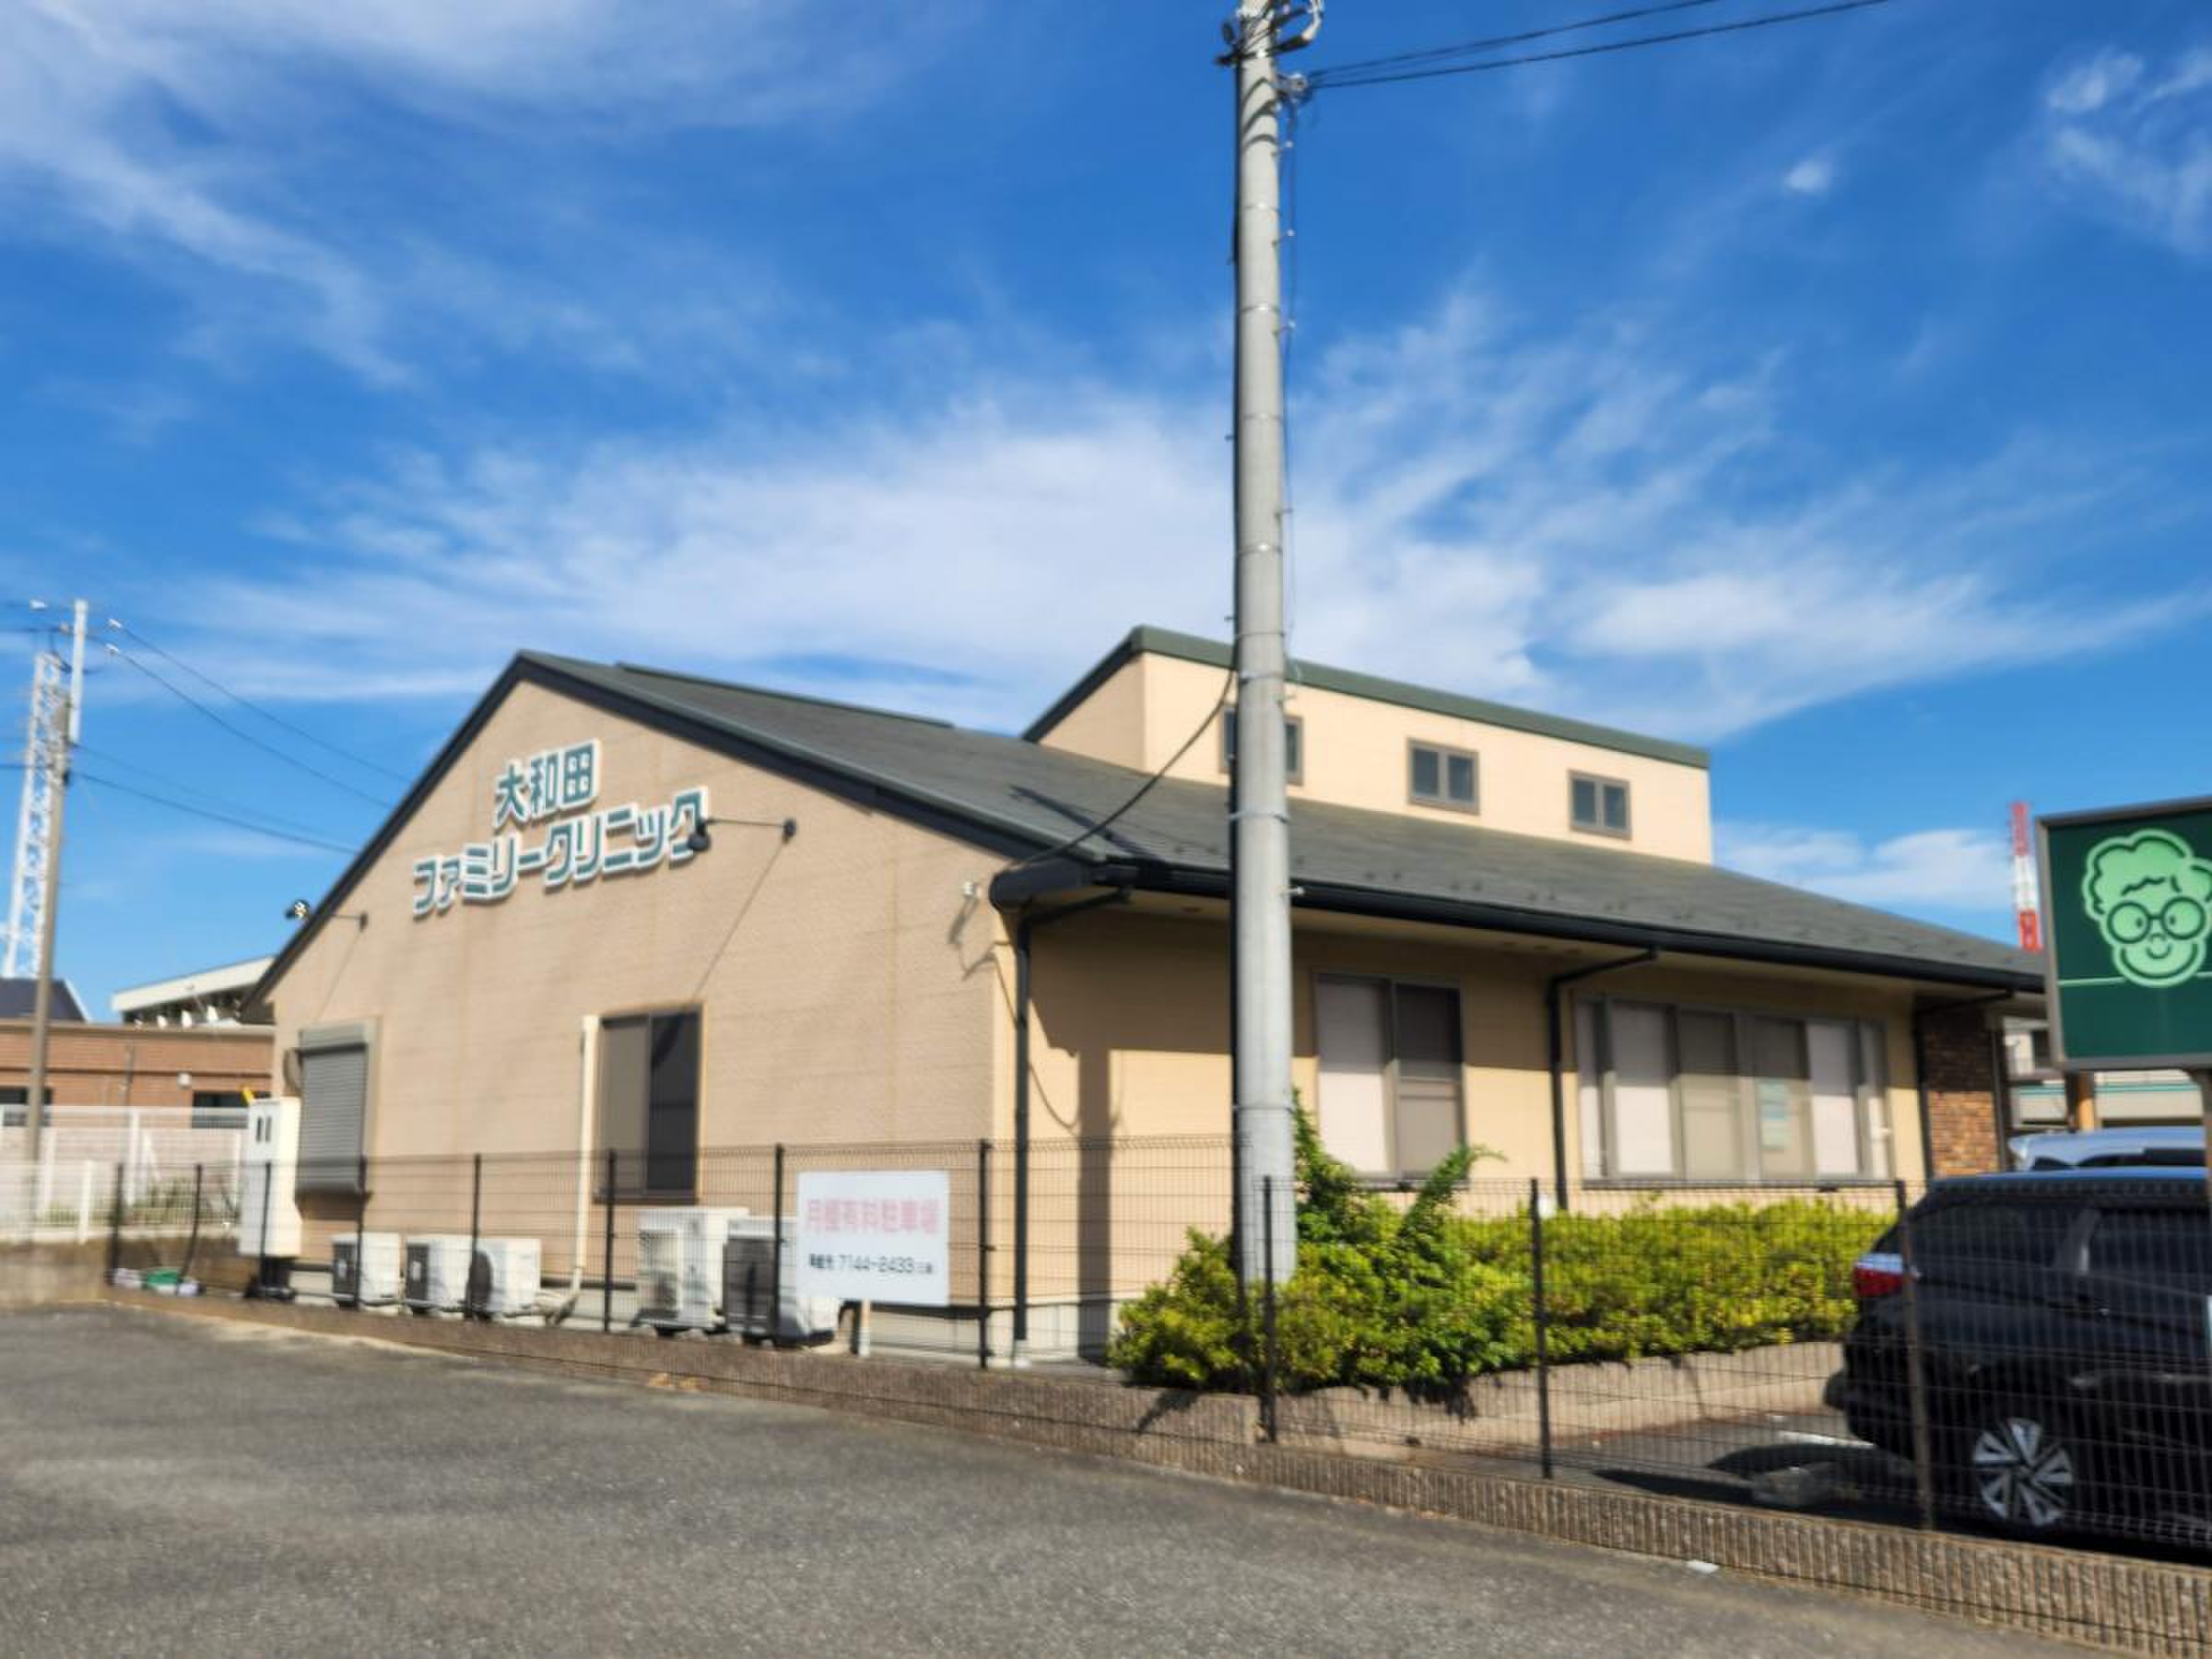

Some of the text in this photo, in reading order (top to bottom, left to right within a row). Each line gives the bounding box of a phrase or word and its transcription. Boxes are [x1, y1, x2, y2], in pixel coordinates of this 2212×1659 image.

[494, 739, 600, 828] 大和田
[414, 786, 708, 914] ファミリークリニック
